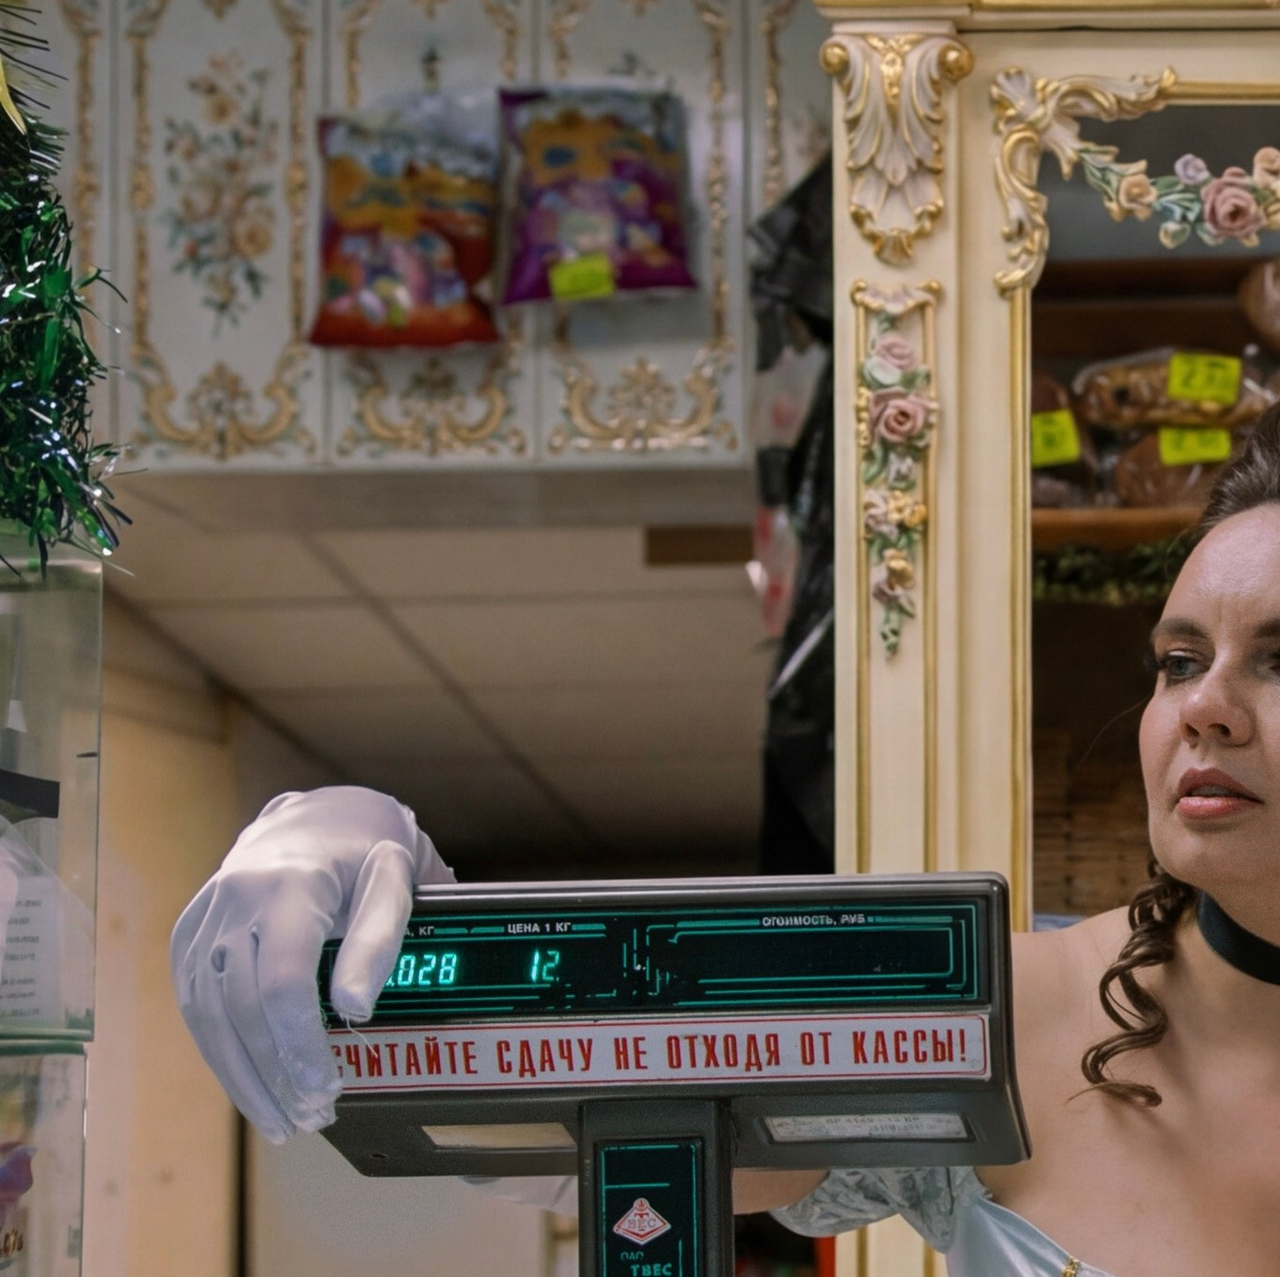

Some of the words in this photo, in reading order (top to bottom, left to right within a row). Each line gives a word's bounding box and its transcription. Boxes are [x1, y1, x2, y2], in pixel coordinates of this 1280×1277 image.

[507, 923, 541, 935] ЦЕНА
[545, 923, 551, 933] 1
[555, 922, 571, 933] КГ
[496, 1038, 593, 1078] СДАЧУ
[614, 1035, 649, 1071] НЕ
[666, 1032, 780, 1074] ОТХОДЯ
[800, 1032, 832, 1066] ОТ
[852, 1028, 966, 1065] КАССЫ!
[631, 1263, 672, 1277] ТВЕС
